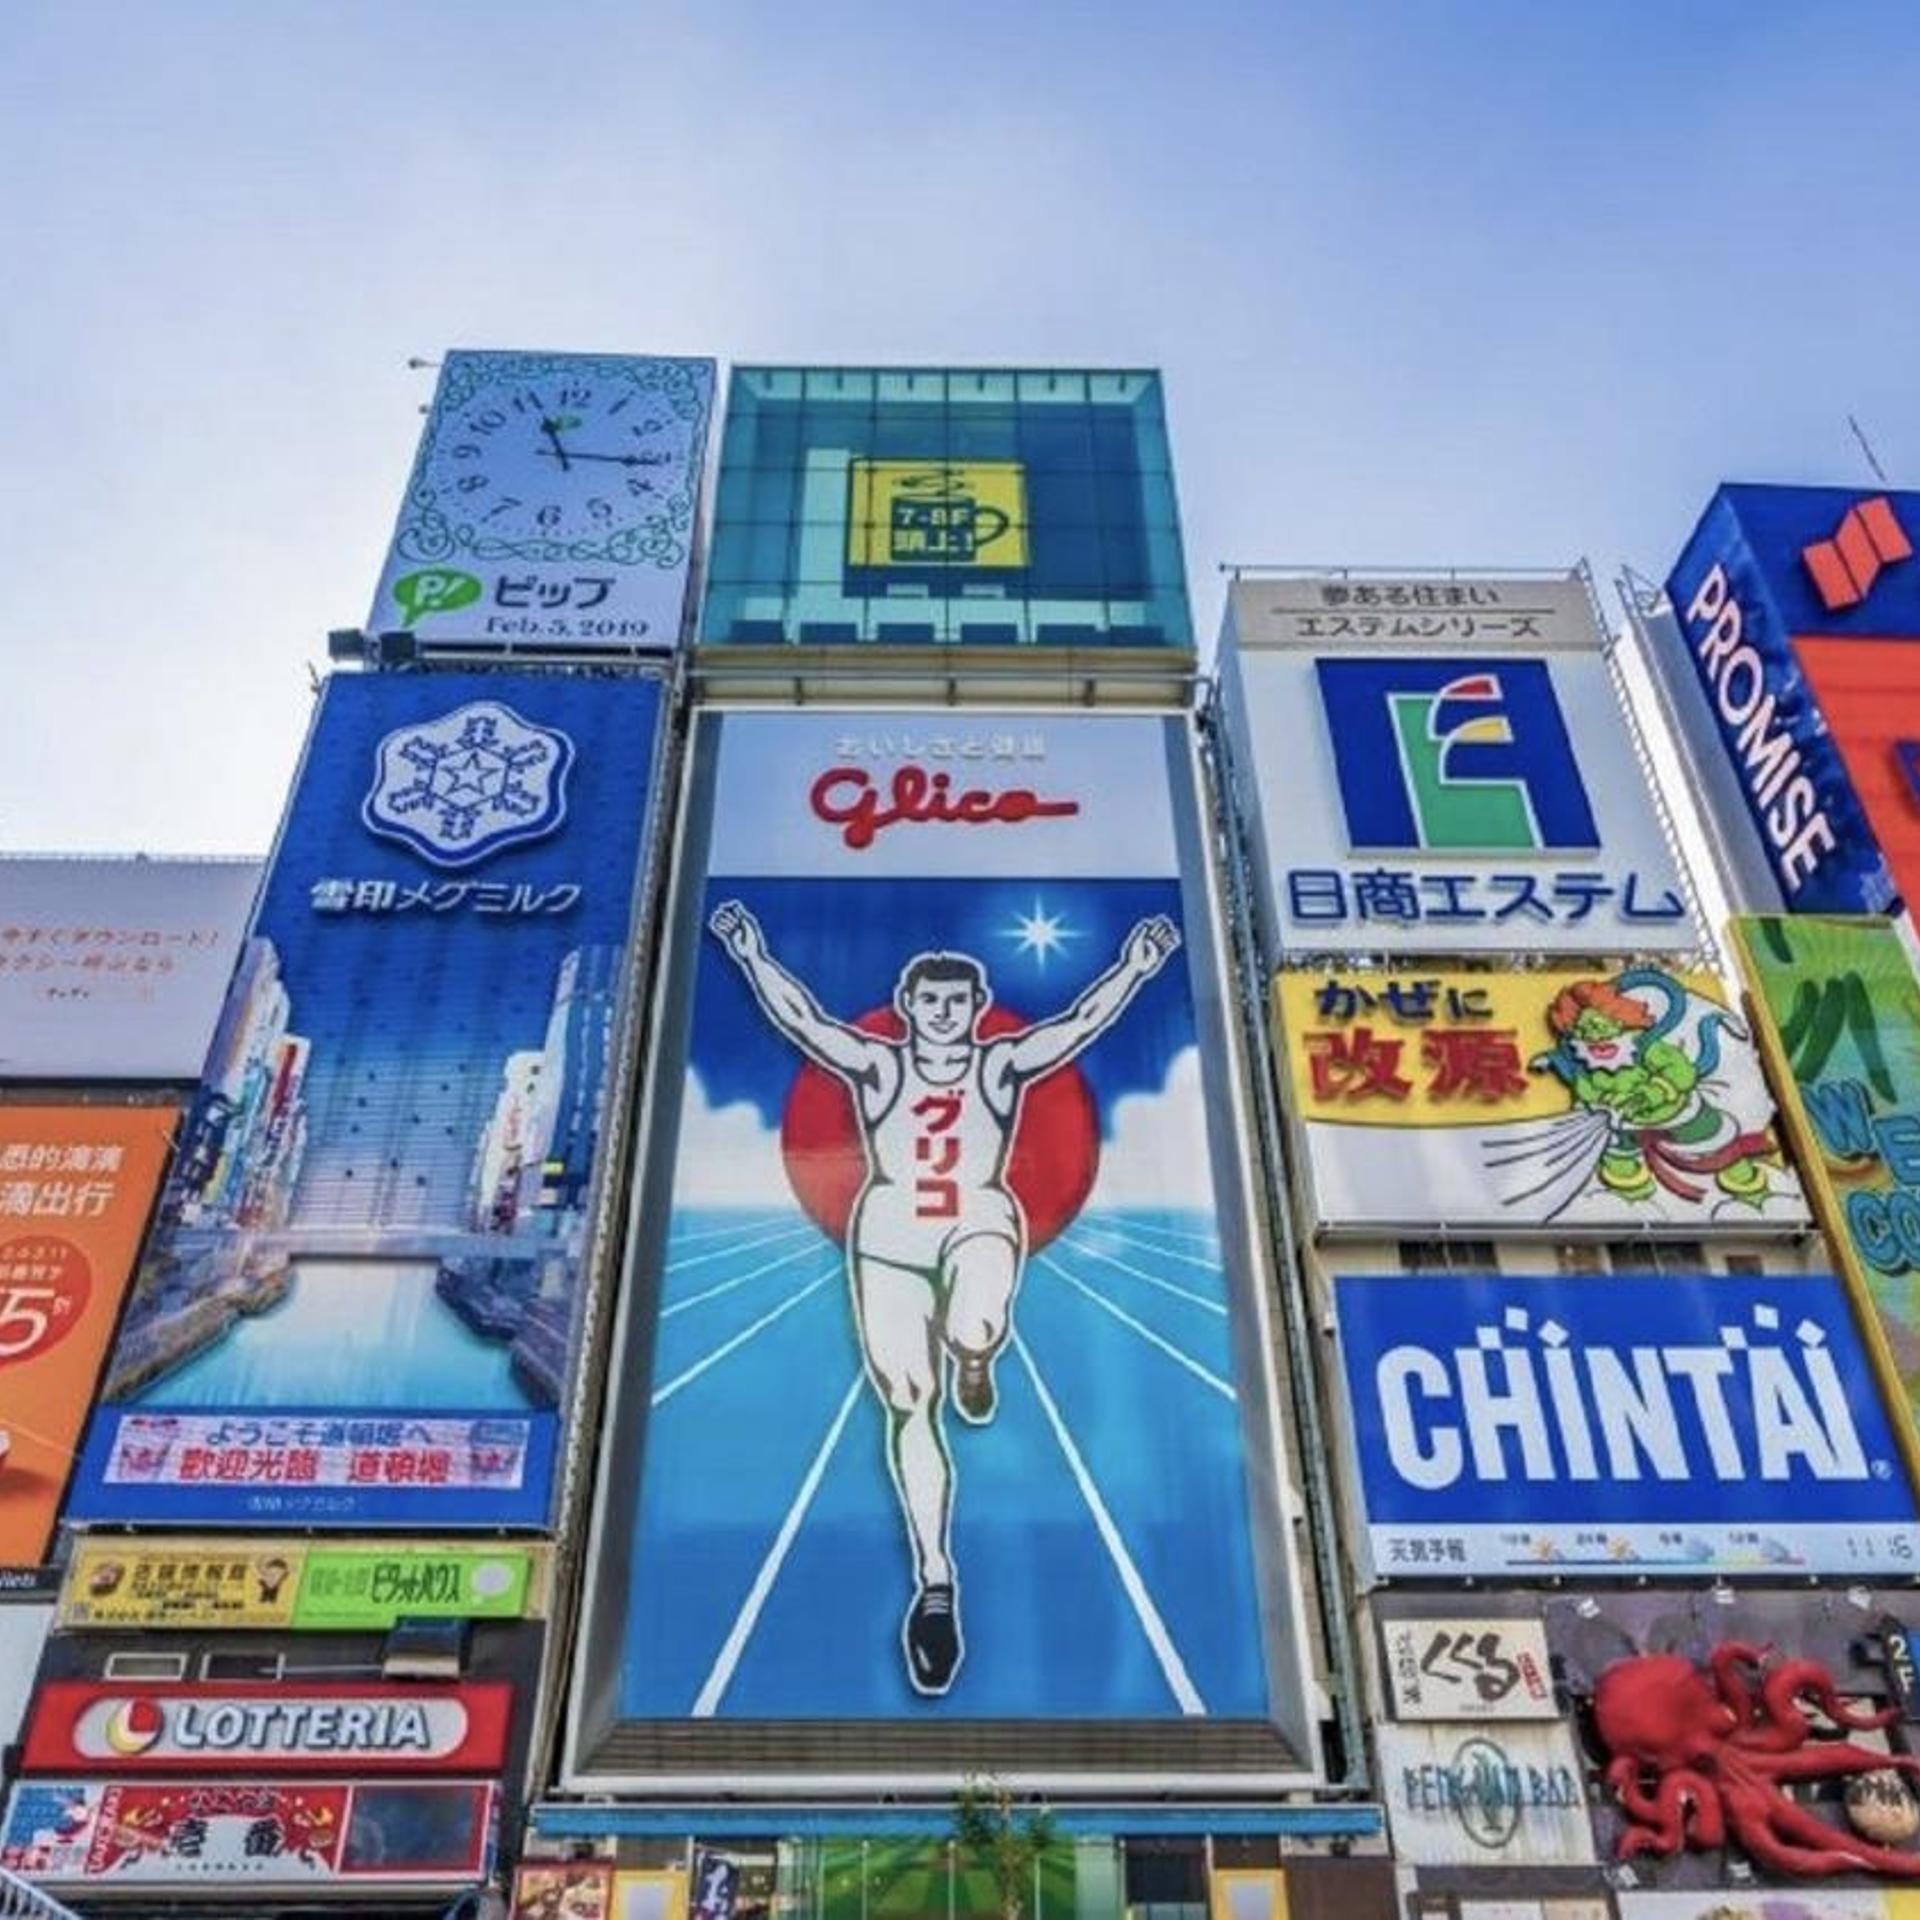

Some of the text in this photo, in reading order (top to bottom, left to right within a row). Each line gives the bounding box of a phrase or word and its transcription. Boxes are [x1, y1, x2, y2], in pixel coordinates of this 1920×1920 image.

[512, 391, 543, 413] 11
[561, 387, 592, 408] 12
[470, 411, 507, 436] 10
[452, 444, 483, 460] 9
[457, 474, 490, 494] 8
[536, 505, 563, 527] 6
[1321, 584, 1500, 607] 夢ある住まい
[579, 619, 649, 637] 2019
[1299, 616, 1542, 639] エステムシリーズ
[1686, 562, 1838, 890] PROMISE
[309, 876, 583, 914] 雪印メグミルク
[1286, 867, 1687, 924] 日商エステム
[1313, 980, 1494, 1019] かぜに
[1302, 1027, 1530, 1102] 改源
[911, 1089, 966, 1218] グリコ
[1376, 1303, 1870, 1490] CHINTAI
[1420, 1631, 1521, 1702] くくる
[173, 1705, 431, 1750] LOTTERIA
